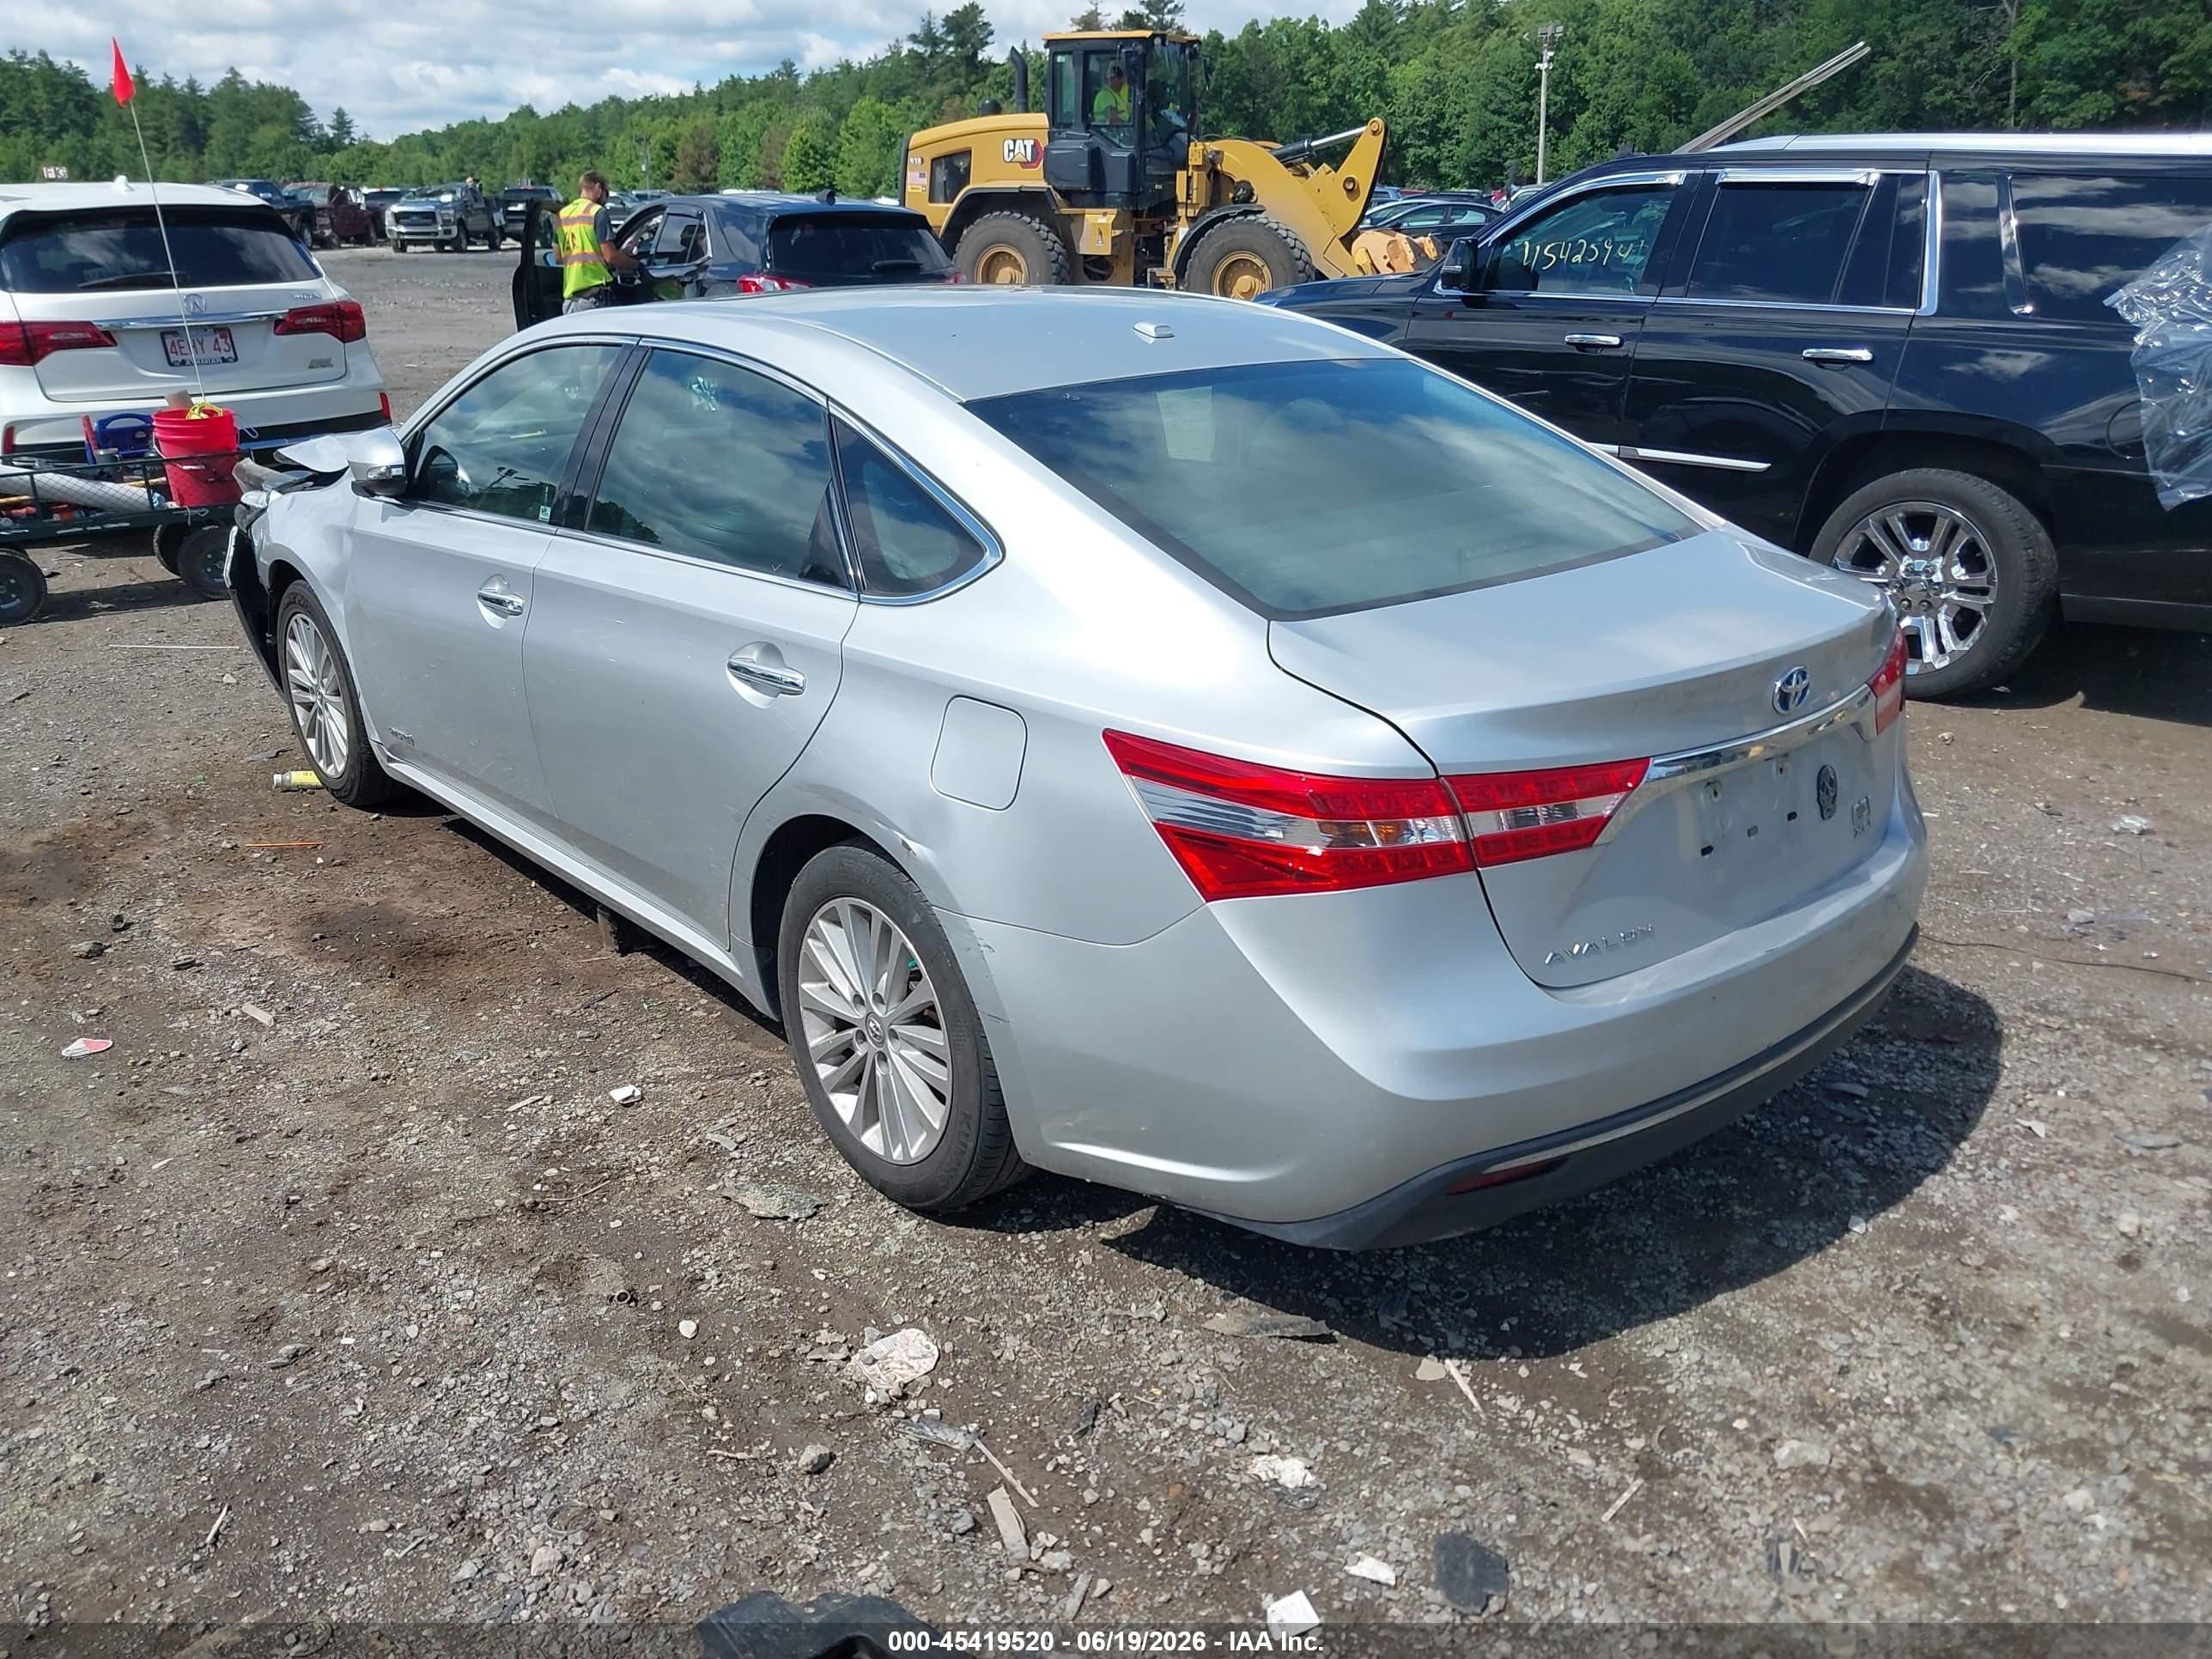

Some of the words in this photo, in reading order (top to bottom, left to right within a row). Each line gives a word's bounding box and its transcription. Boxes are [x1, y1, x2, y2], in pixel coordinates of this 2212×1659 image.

[1003, 138, 1035, 162] CAT
[213, 334, 232, 354] 43
[1545, 923, 1656, 965] AVALON
